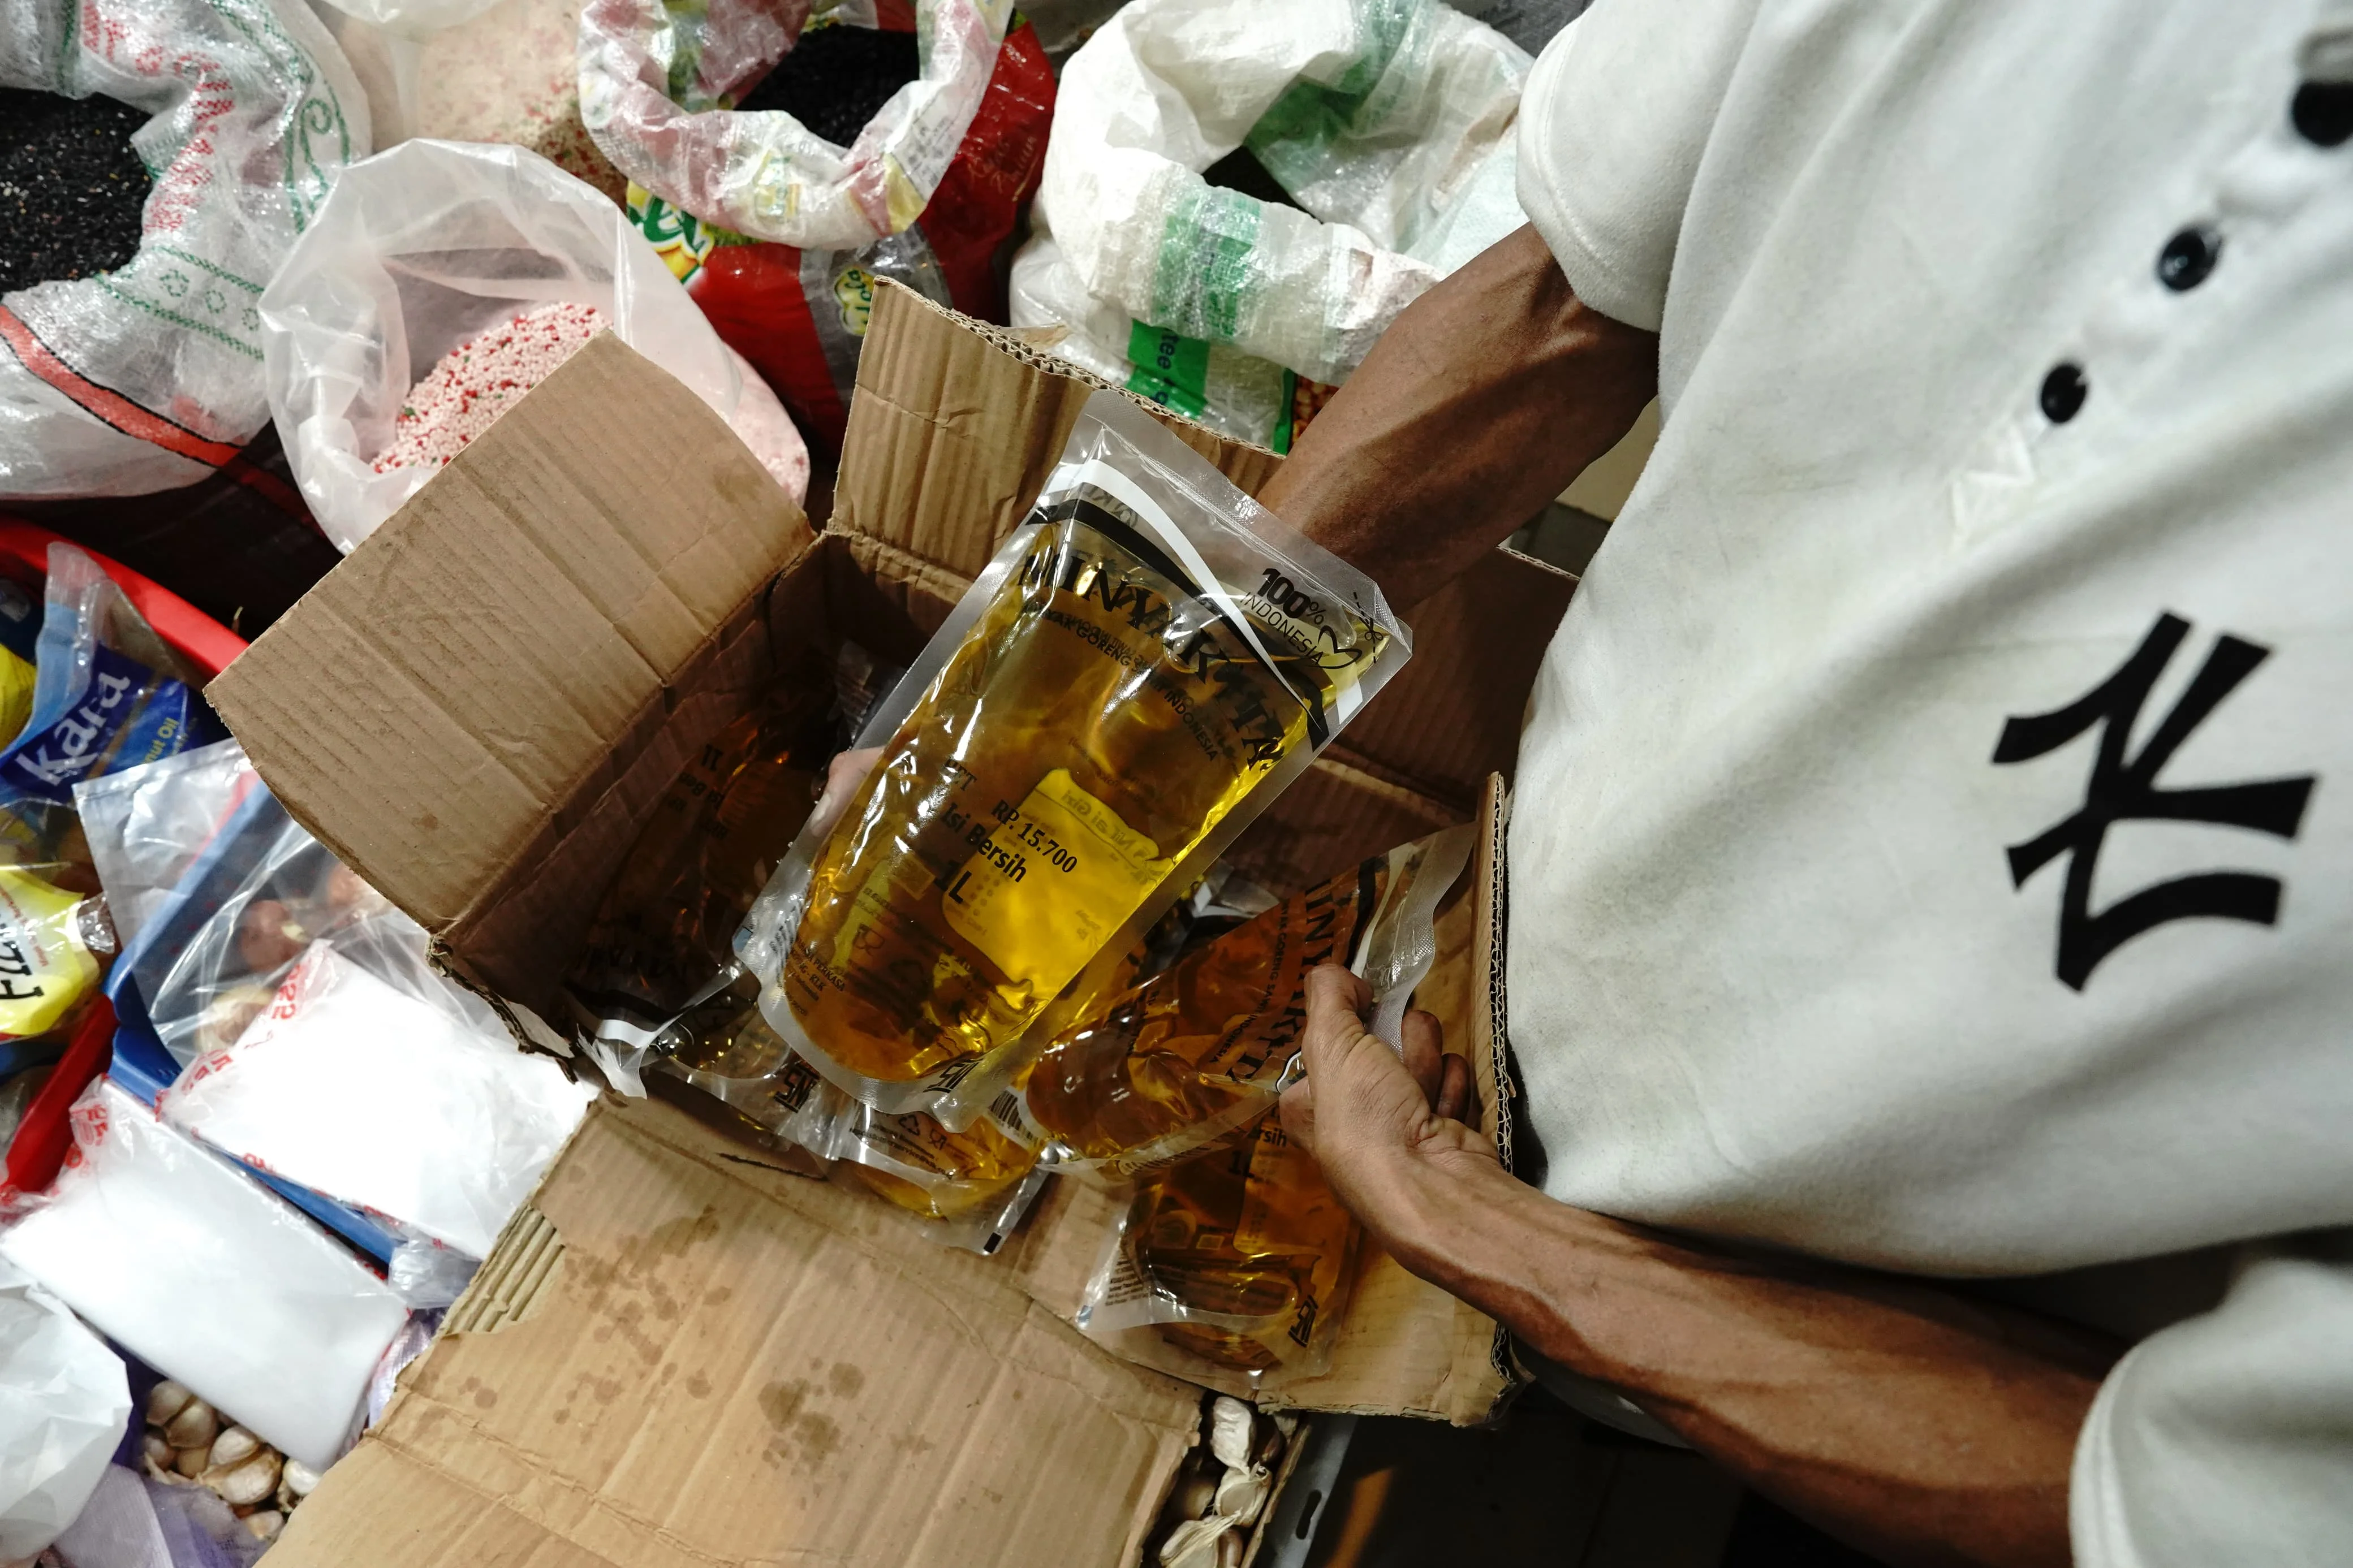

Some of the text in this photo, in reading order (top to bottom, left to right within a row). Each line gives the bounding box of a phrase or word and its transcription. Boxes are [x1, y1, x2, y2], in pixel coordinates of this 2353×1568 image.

[1257, 568, 1326, 625] 100%
[1240, 592, 1324, 666] INDONESIA
[157, 718, 180, 739] Oil
[1163, 690, 1218, 761] INDONESIA
[940, 802, 1027, 883] Isi Bersih
[1018, 823, 1078, 873] 15.700
[934, 859, 972, 904] 1L
